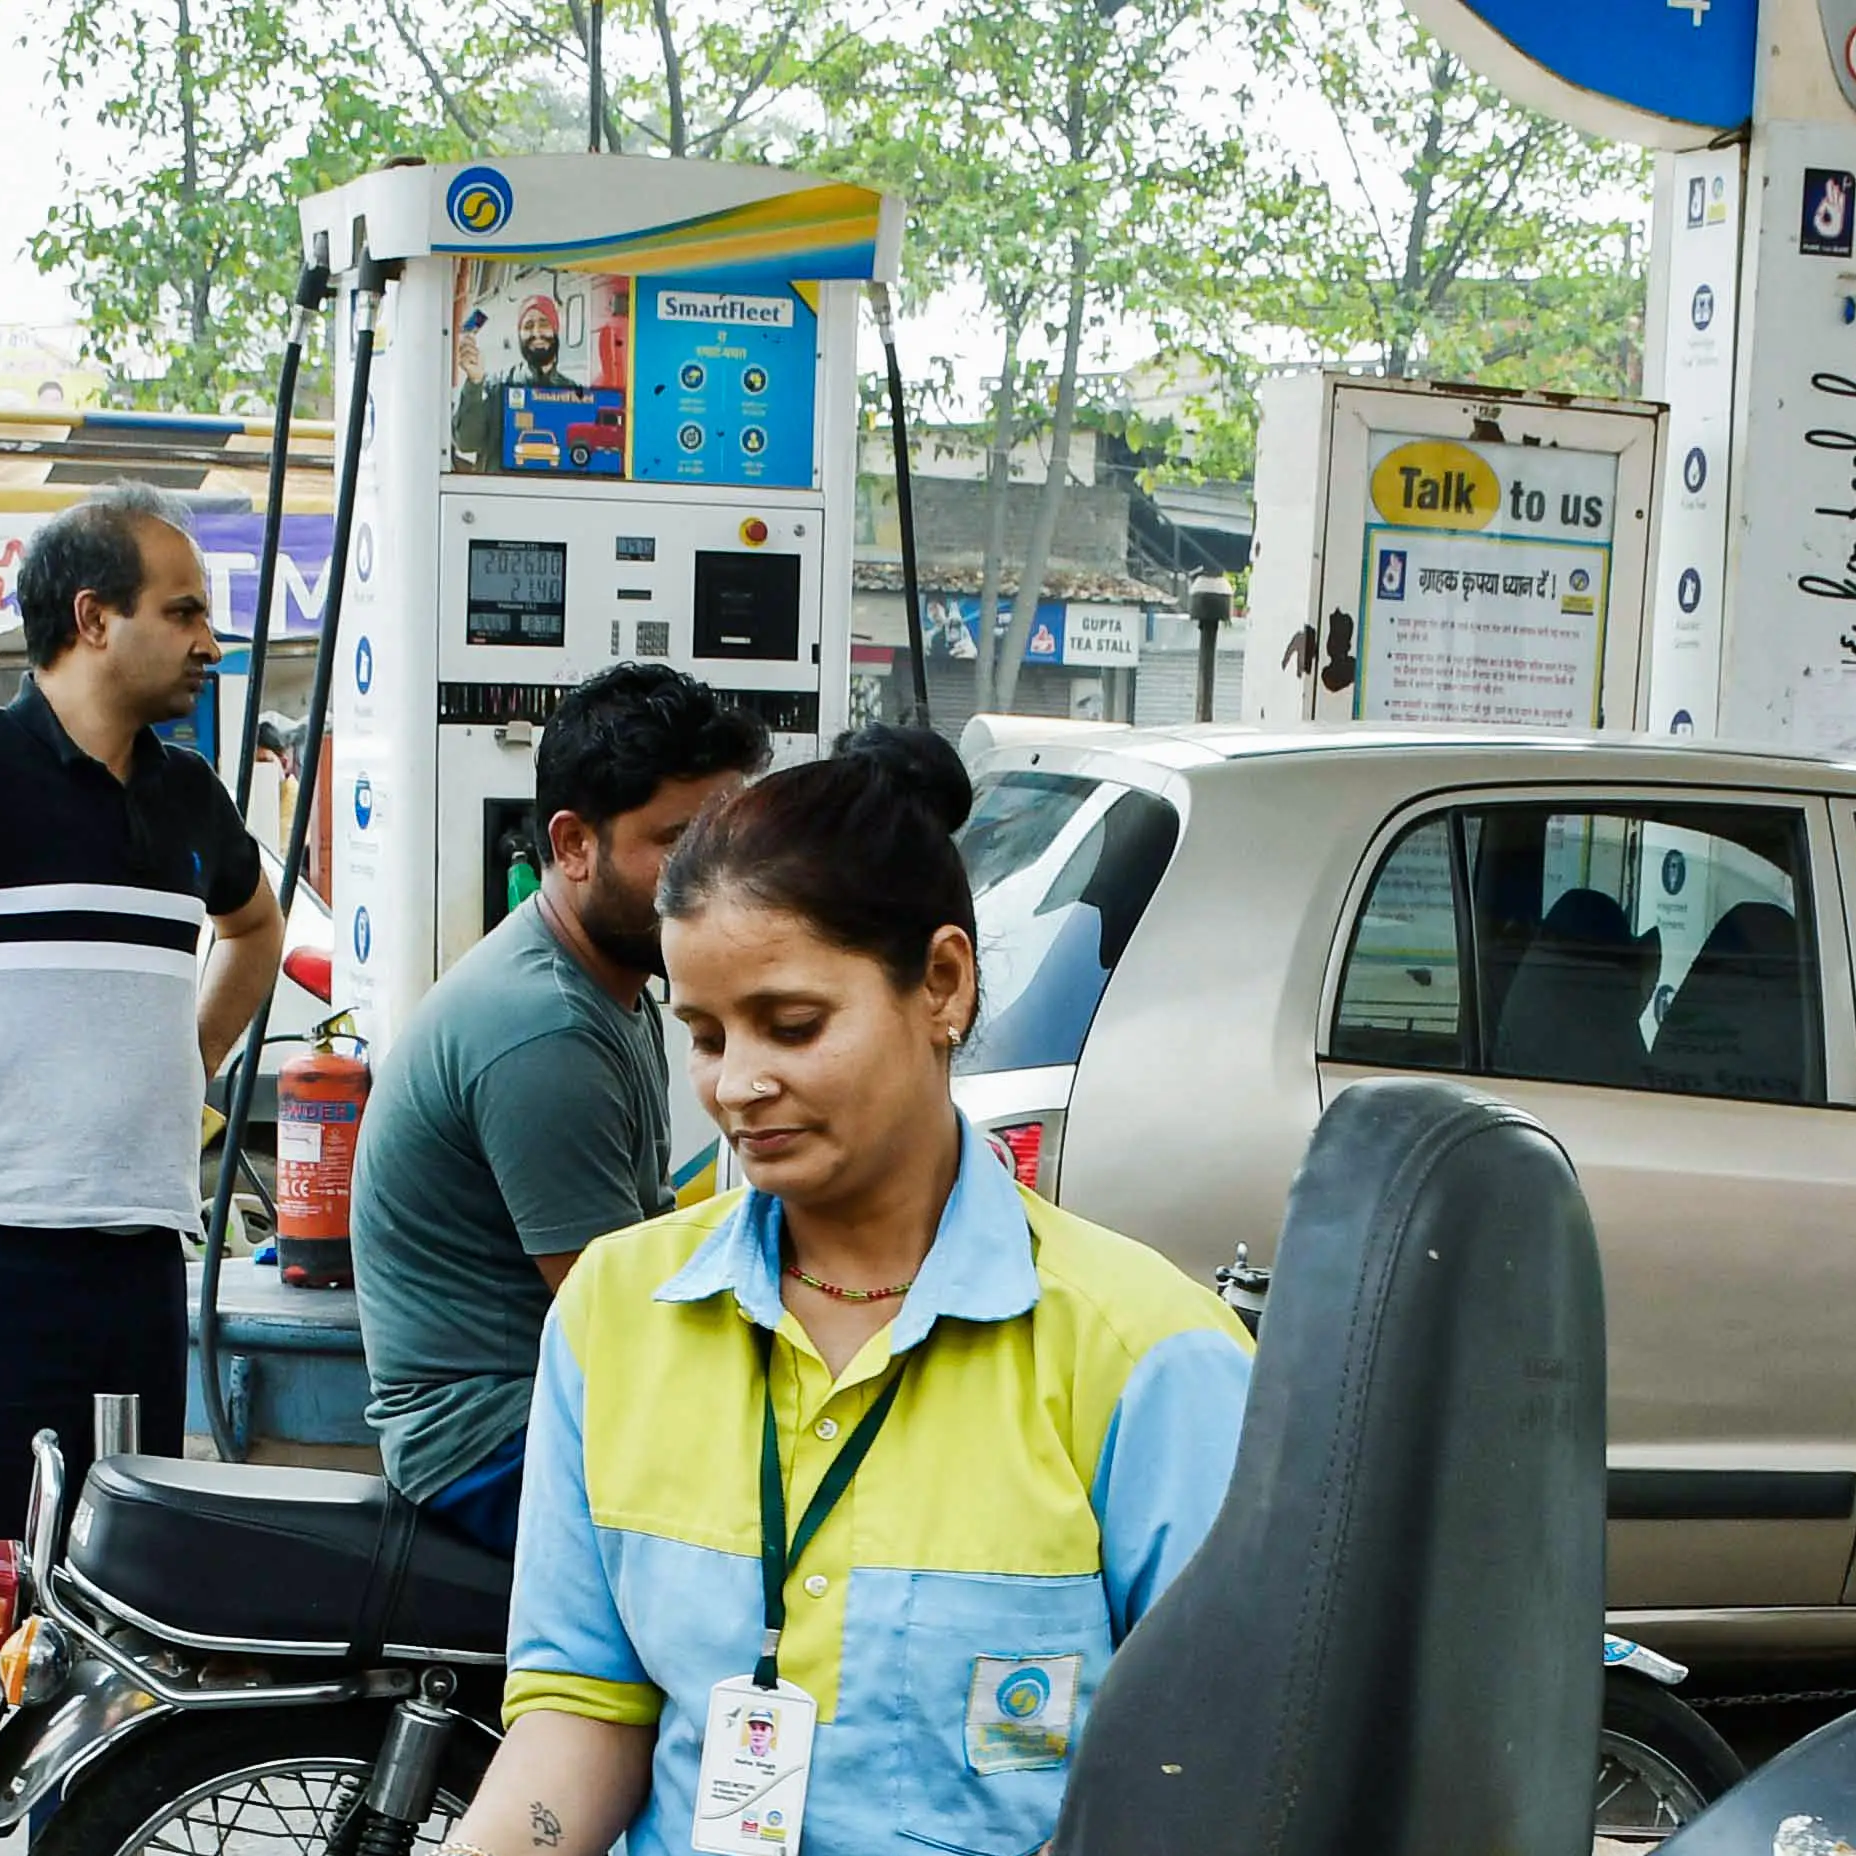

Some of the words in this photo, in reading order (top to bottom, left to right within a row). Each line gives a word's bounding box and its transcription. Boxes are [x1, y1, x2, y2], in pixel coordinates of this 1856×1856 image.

[663, 296, 781, 322] SmartFleet
[1399, 466, 1476, 515] Talk
[1510, 480, 1545, 523] to
[1560, 494, 1602, 528] us
[1419, 567, 1459, 596] ग्राहक
[1082, 615, 1122, 632] GUPTA
[1070, 637, 1092, 651] TEA
[1096, 638, 1132, 654] STALL
